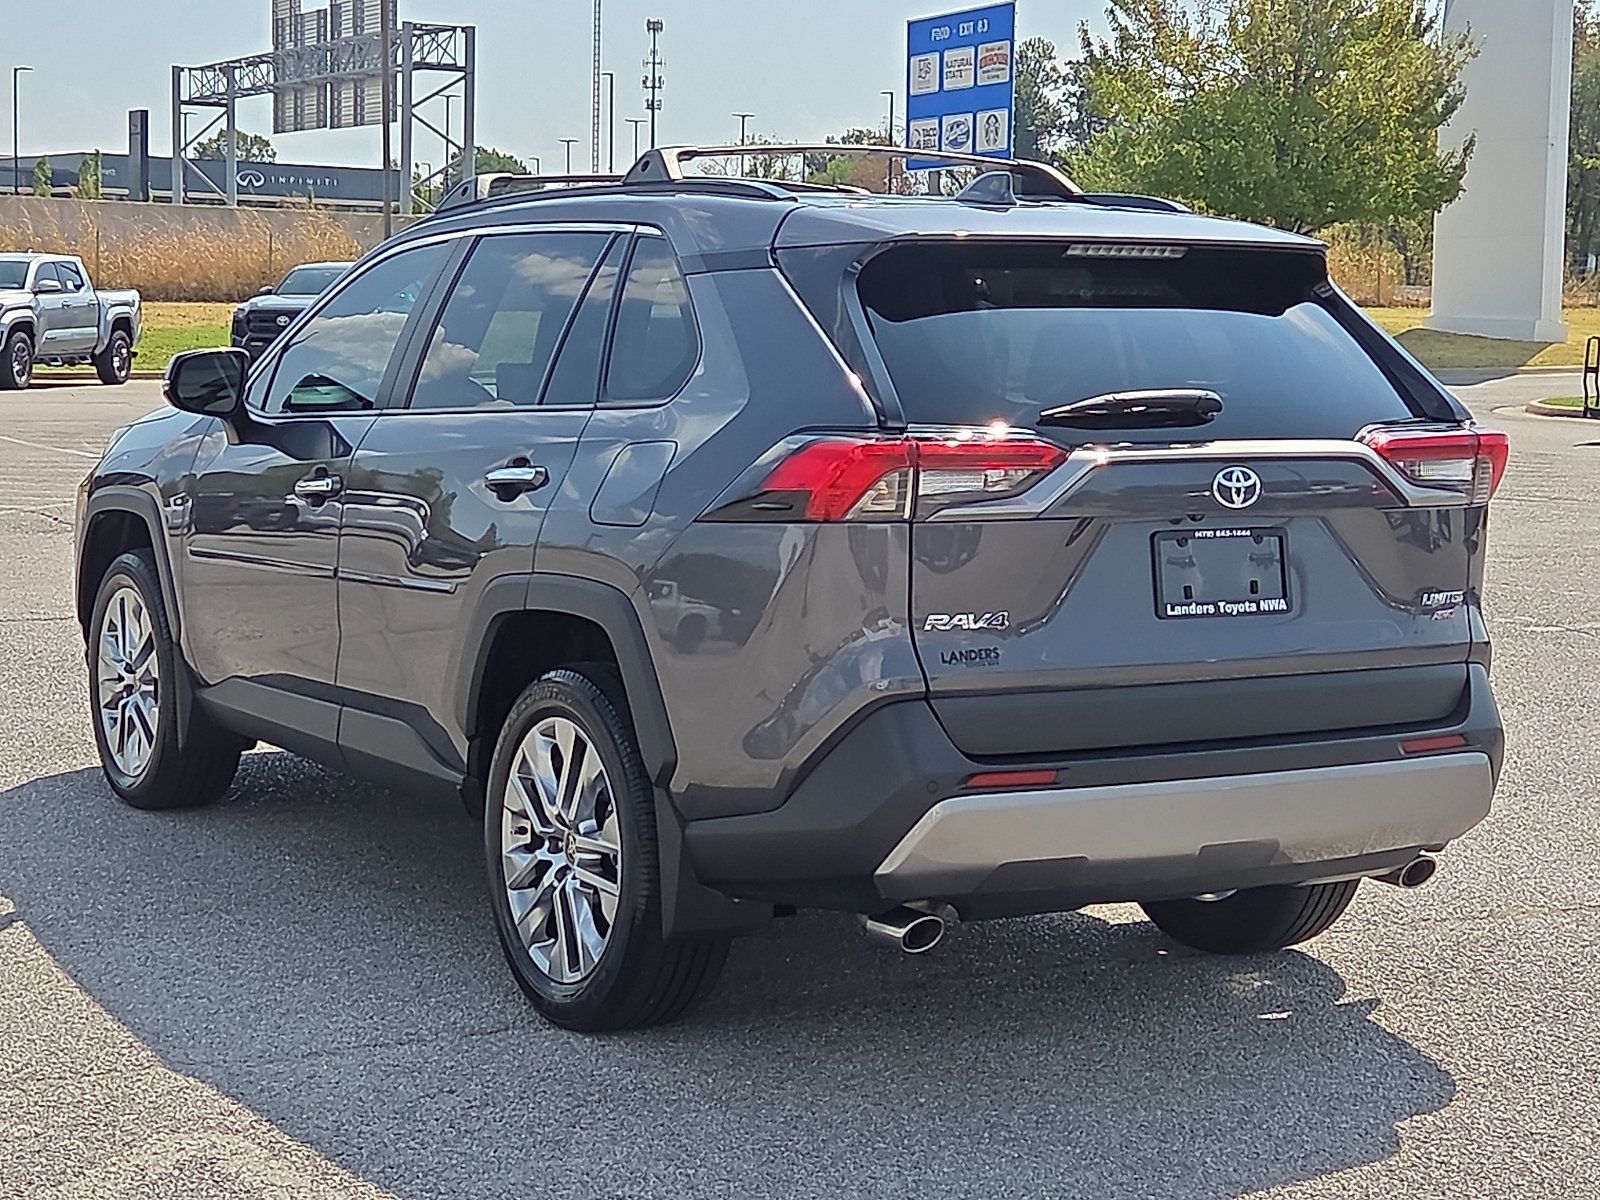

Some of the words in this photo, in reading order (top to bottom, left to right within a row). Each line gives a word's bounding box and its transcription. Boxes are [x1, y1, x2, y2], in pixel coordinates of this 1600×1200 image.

[931, 26, 951, 41] FOOD
[959, 21, 975, 37] EXIT
[945, 57, 973, 69] NATURAL
[945, 69, 963, 80] STATE
[922, 127, 937, 138] TACO
[922, 138, 937, 149] BELL
[270, 175, 339, 187] INFINITI
[1166, 603, 1216, 616] Landers
[1217, 601, 1258, 615] Toyota
[1259, 599, 1288, 612] NWA
[923, 611, 1010, 631] RAV4
[941, 646, 1001, 665] LANDERS
